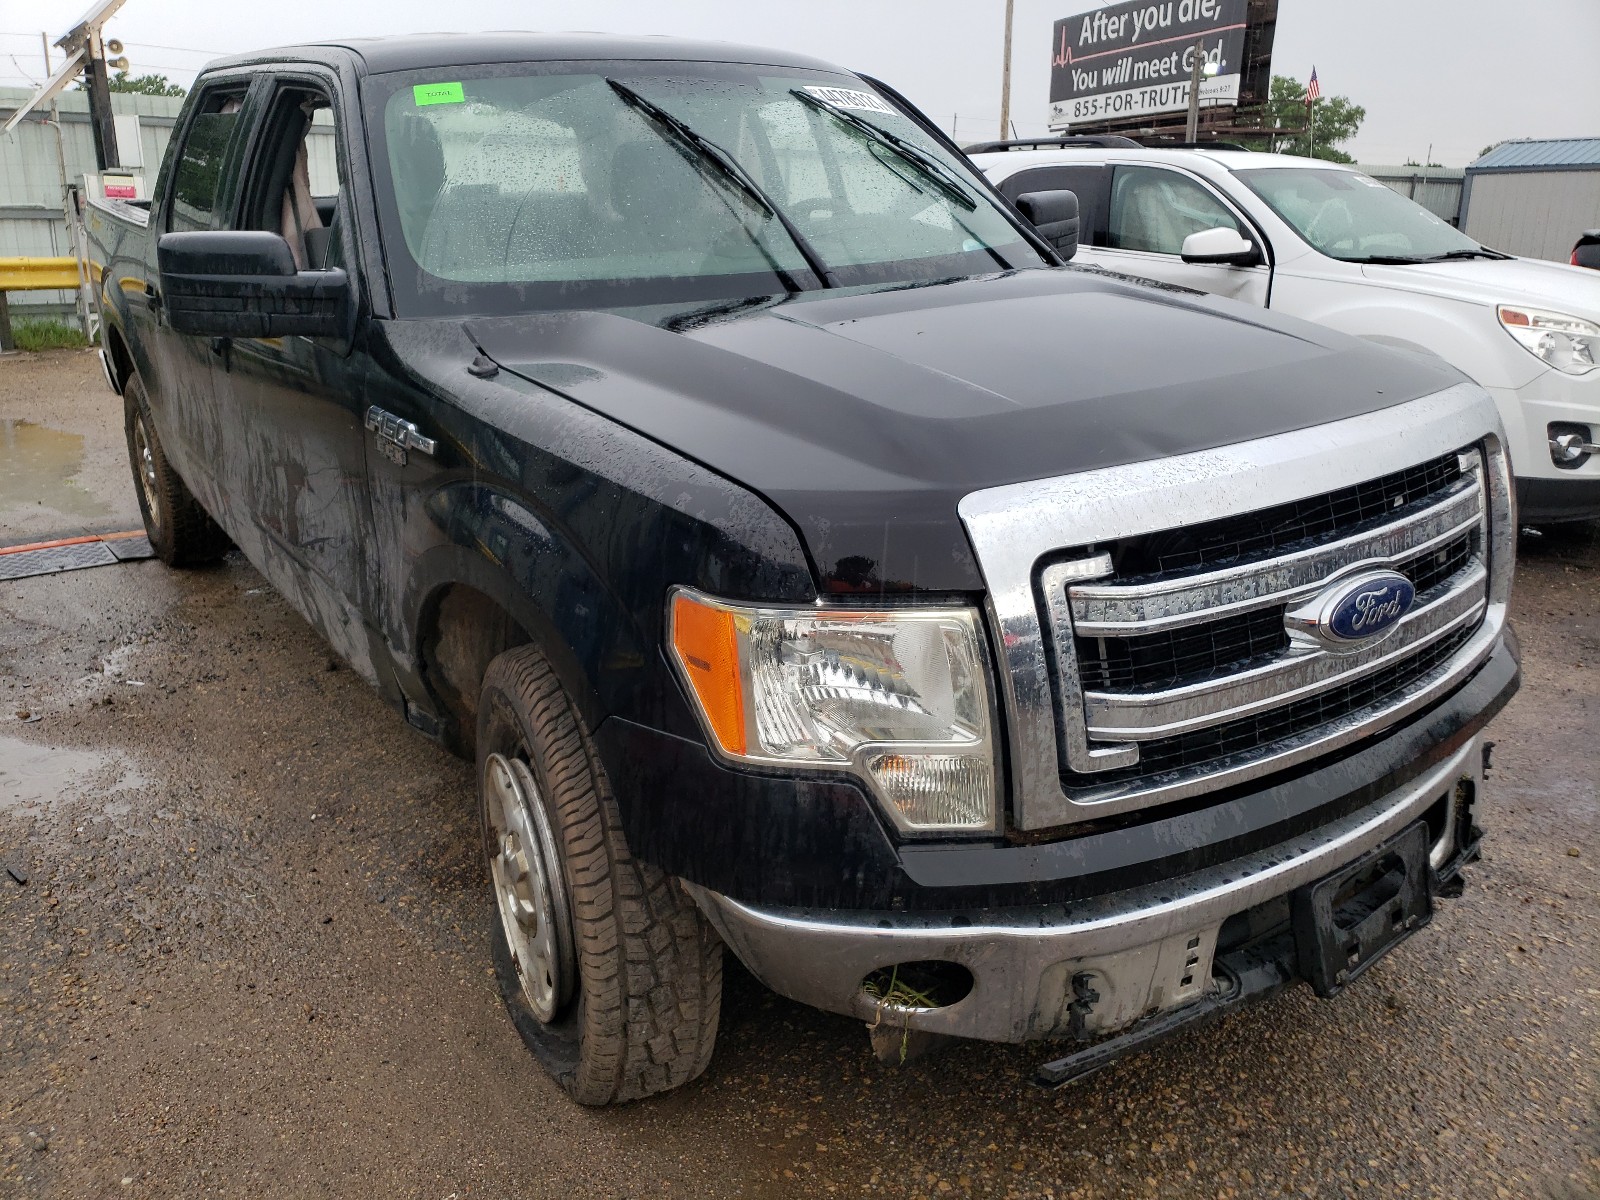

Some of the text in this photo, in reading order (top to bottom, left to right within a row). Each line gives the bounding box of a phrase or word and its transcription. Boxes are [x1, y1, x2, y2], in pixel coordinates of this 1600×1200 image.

[1079, 11, 1128, 46] After
[1132, 2, 1173, 42] you
[1071, 68, 1097, 91] You
[1102, 56, 1132, 86] will
[1133, 51, 1178, 81] meet
[1074, 84, 1192, 117] 855-FOR-TRUTH
[1352, 586, 1401, 631] Ford
